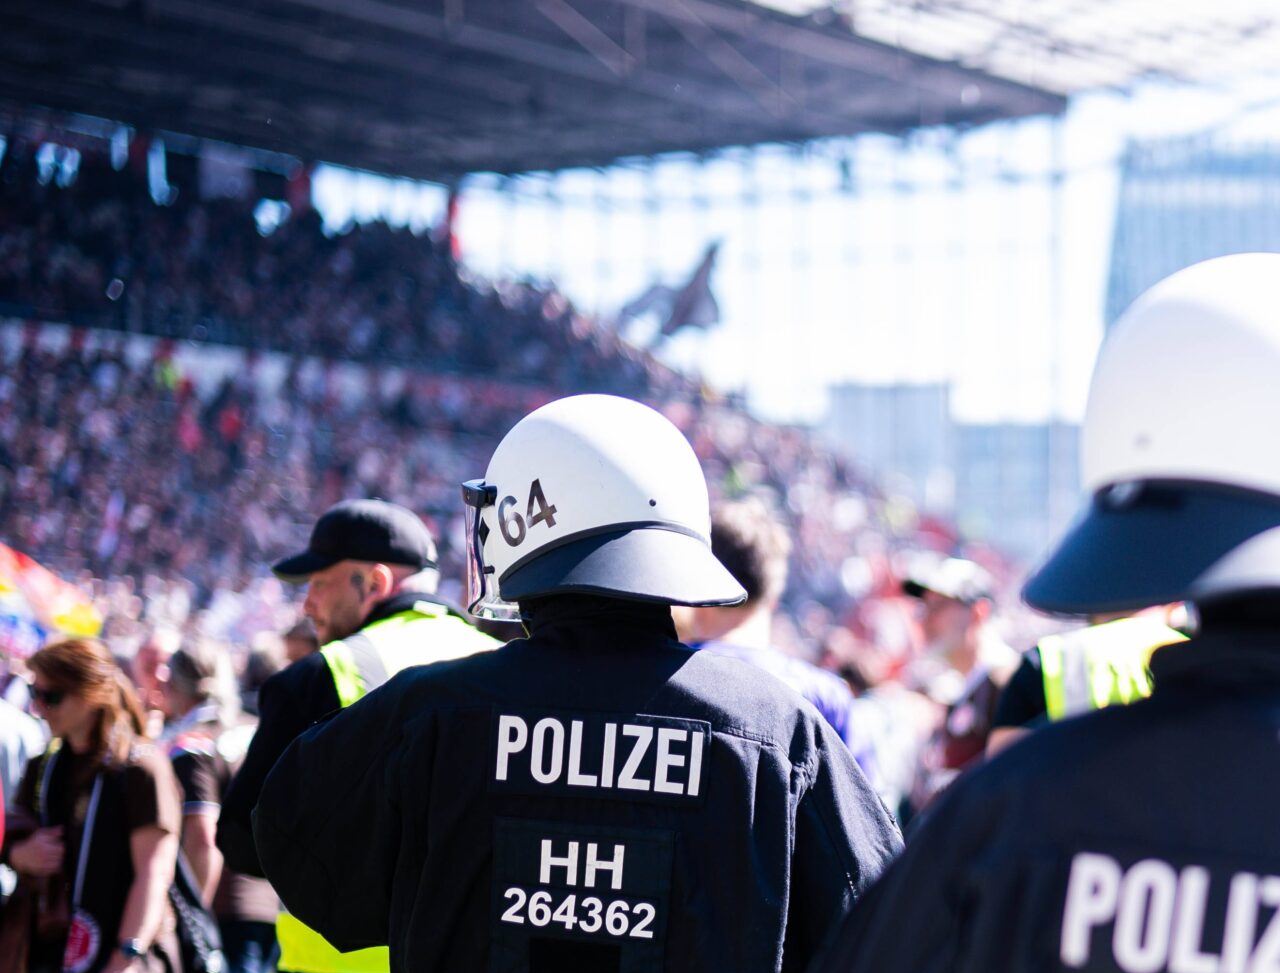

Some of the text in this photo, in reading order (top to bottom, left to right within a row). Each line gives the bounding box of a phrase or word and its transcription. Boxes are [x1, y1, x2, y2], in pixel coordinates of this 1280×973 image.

[498, 478, 557, 547] 64
[495, 714, 704, 796] POLIZEI
[539, 839, 625, 890] HH
[501, 887, 656, 939] 264362
